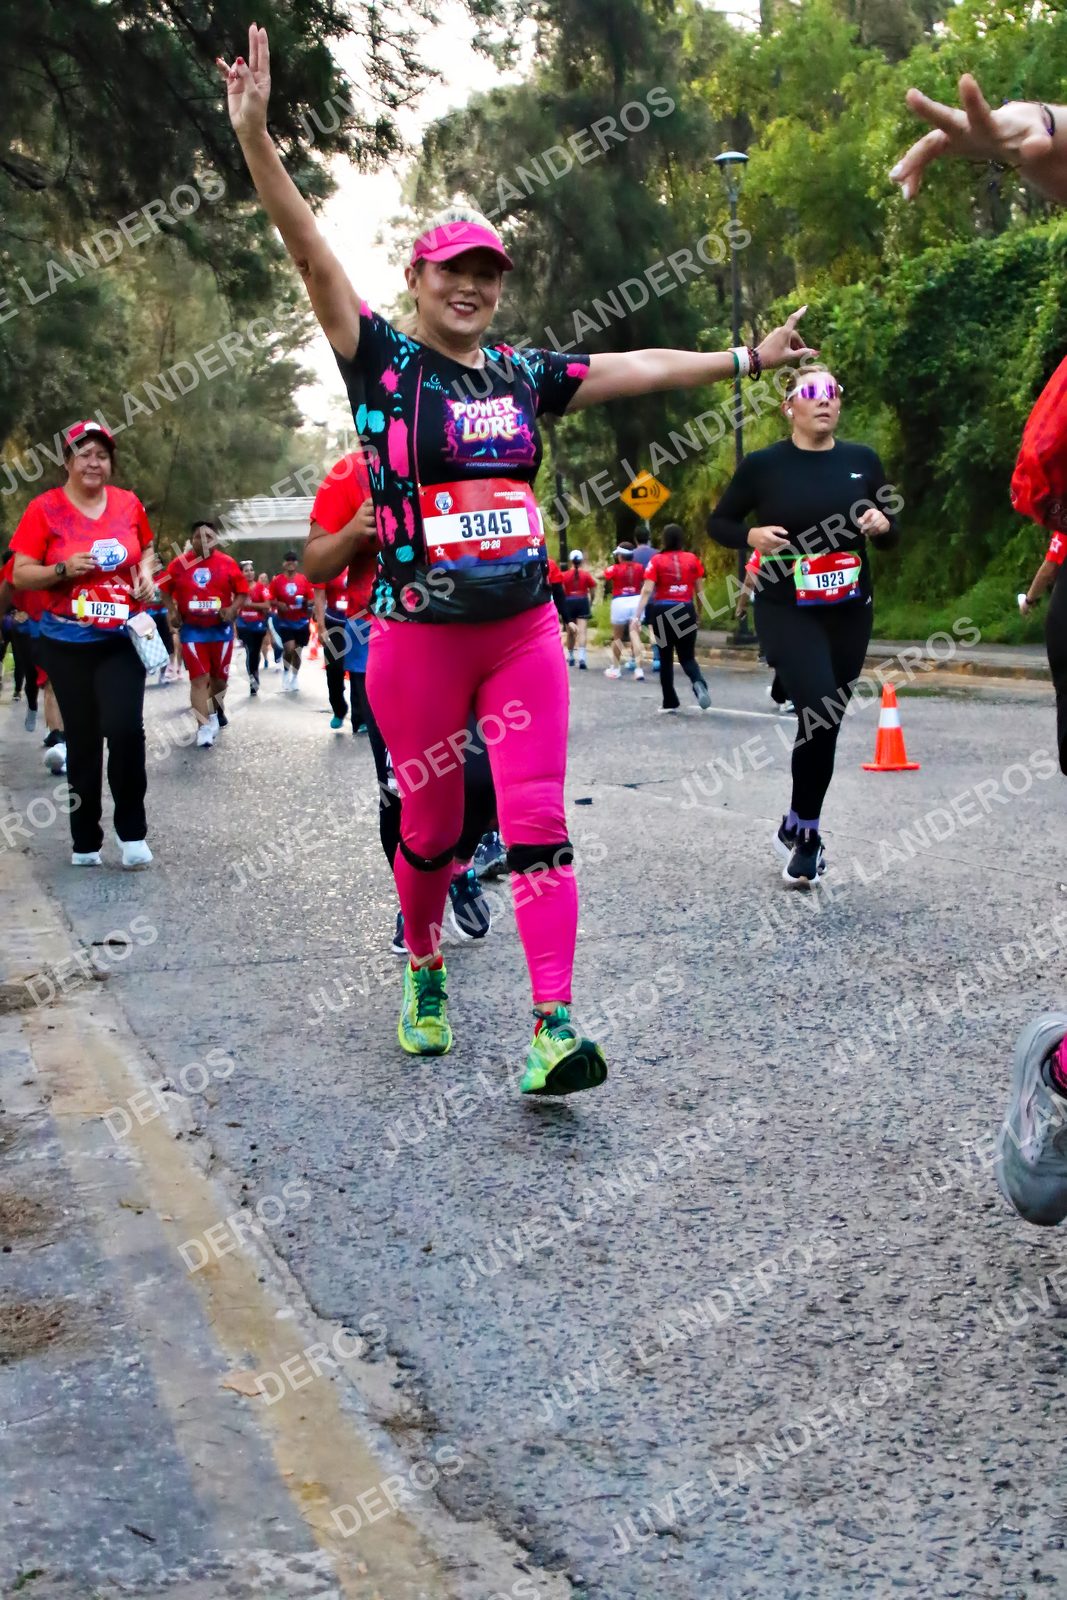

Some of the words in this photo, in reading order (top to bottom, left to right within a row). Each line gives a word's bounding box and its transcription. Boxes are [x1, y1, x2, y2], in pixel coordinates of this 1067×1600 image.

[451, 397, 522, 420] POWER
[462, 414, 520, 442] LORE
[460, 511, 512, 538] 3345
[816, 572, 844, 588] 1923
[91, 603, 116, 616] 1829
